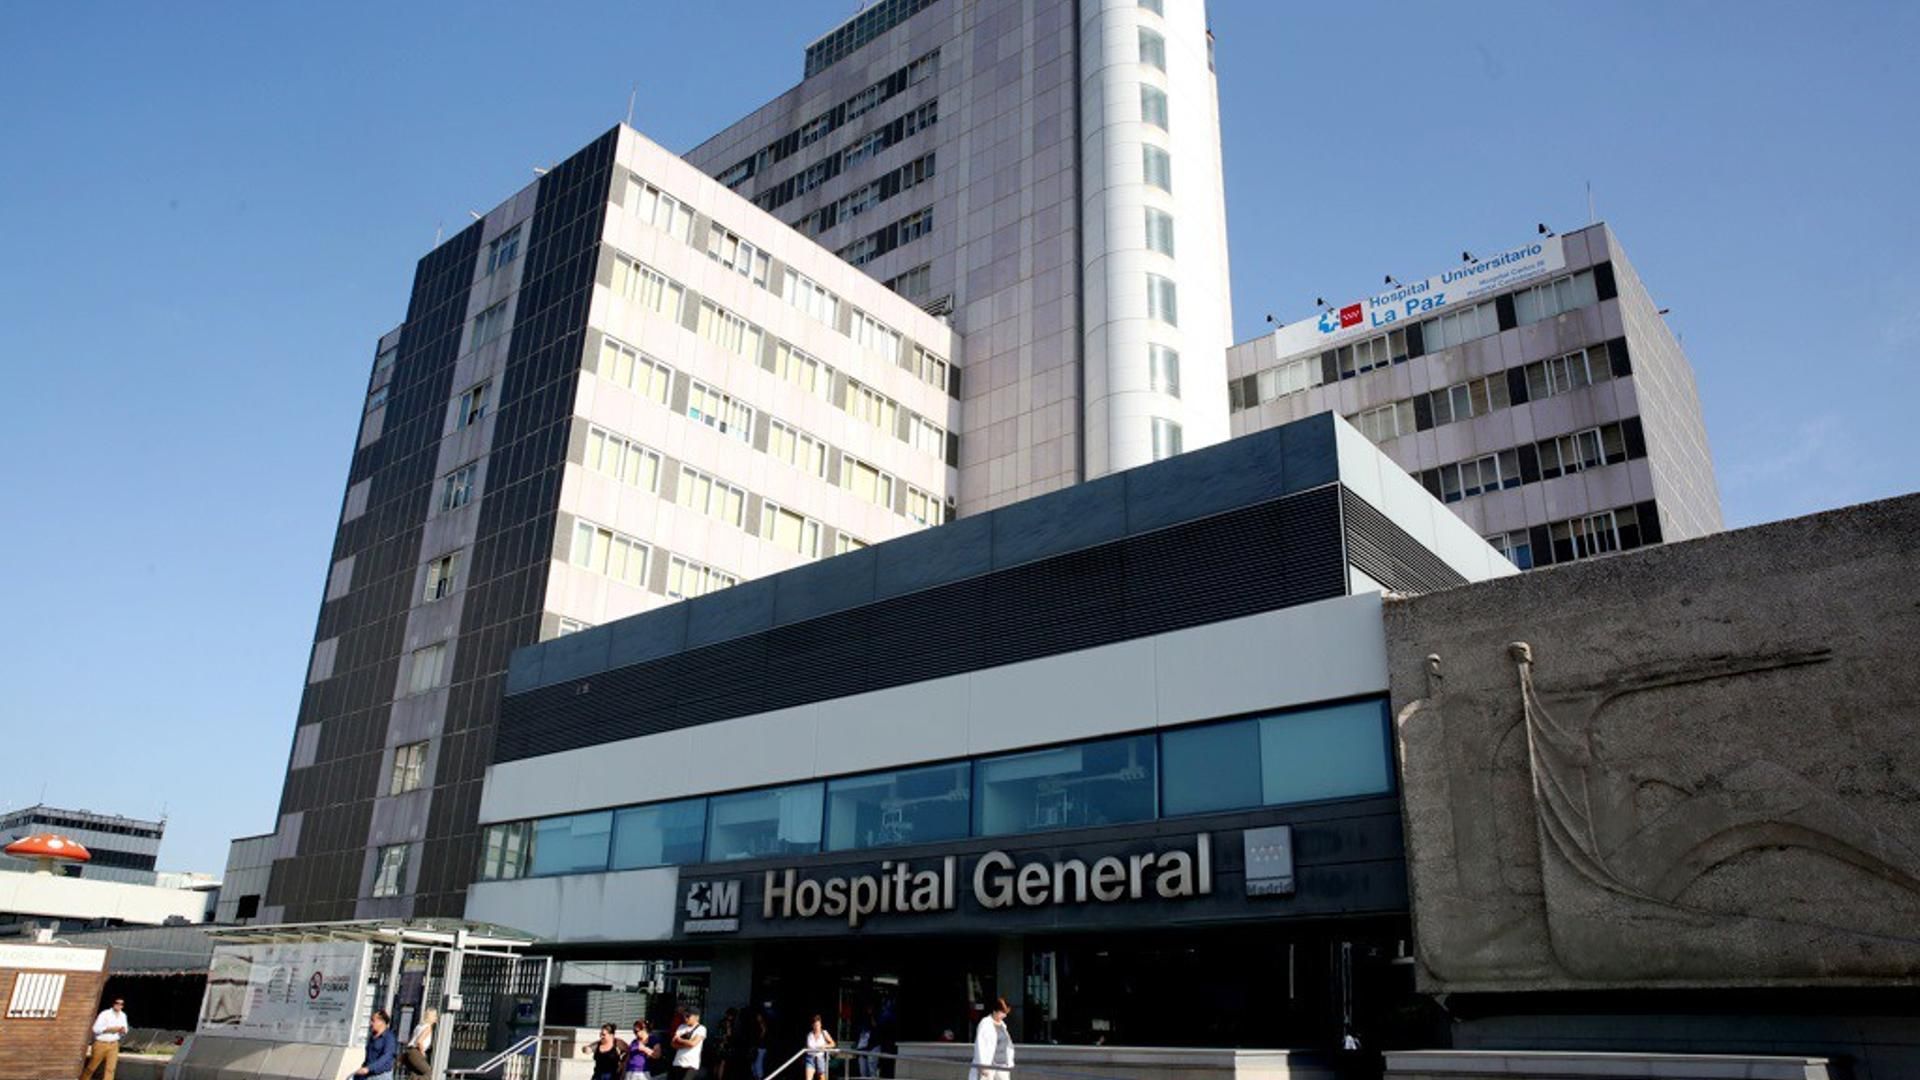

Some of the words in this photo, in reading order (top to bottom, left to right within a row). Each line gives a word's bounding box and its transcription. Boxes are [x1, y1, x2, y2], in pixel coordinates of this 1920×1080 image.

[1369, 280, 1430, 309] Hospital
[1441, 243, 1542, 285] Universitario
[1370, 308, 1397, 328] La
[1404, 292, 1447, 317] Paz
[762, 855, 957, 928] Hospital
[972, 832, 1212, 909] General
[1247, 881, 1293, 896] Madrid
